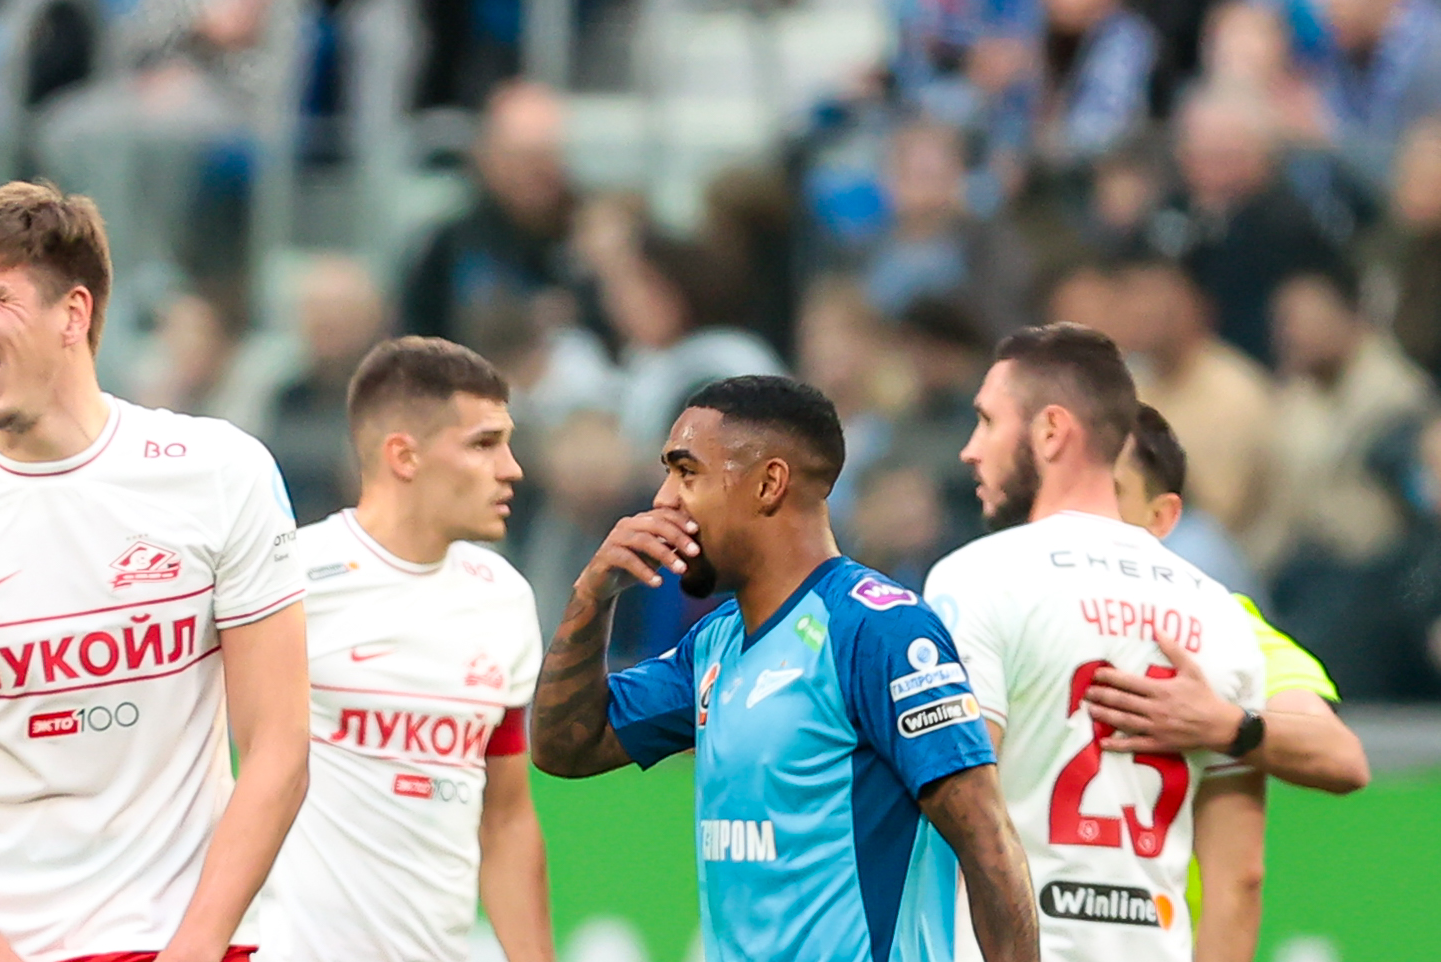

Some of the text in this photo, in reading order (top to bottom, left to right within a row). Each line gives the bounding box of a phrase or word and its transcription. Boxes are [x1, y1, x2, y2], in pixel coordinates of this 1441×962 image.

[1050, 551, 1202, 589] CHERY
[1080, 598, 1203, 653] ЧЕРНОВ
[330, 707, 490, 760] ЛУКОЙ
[904, 704, 963, 731] Winline
[1051, 884, 1158, 923] Winline
